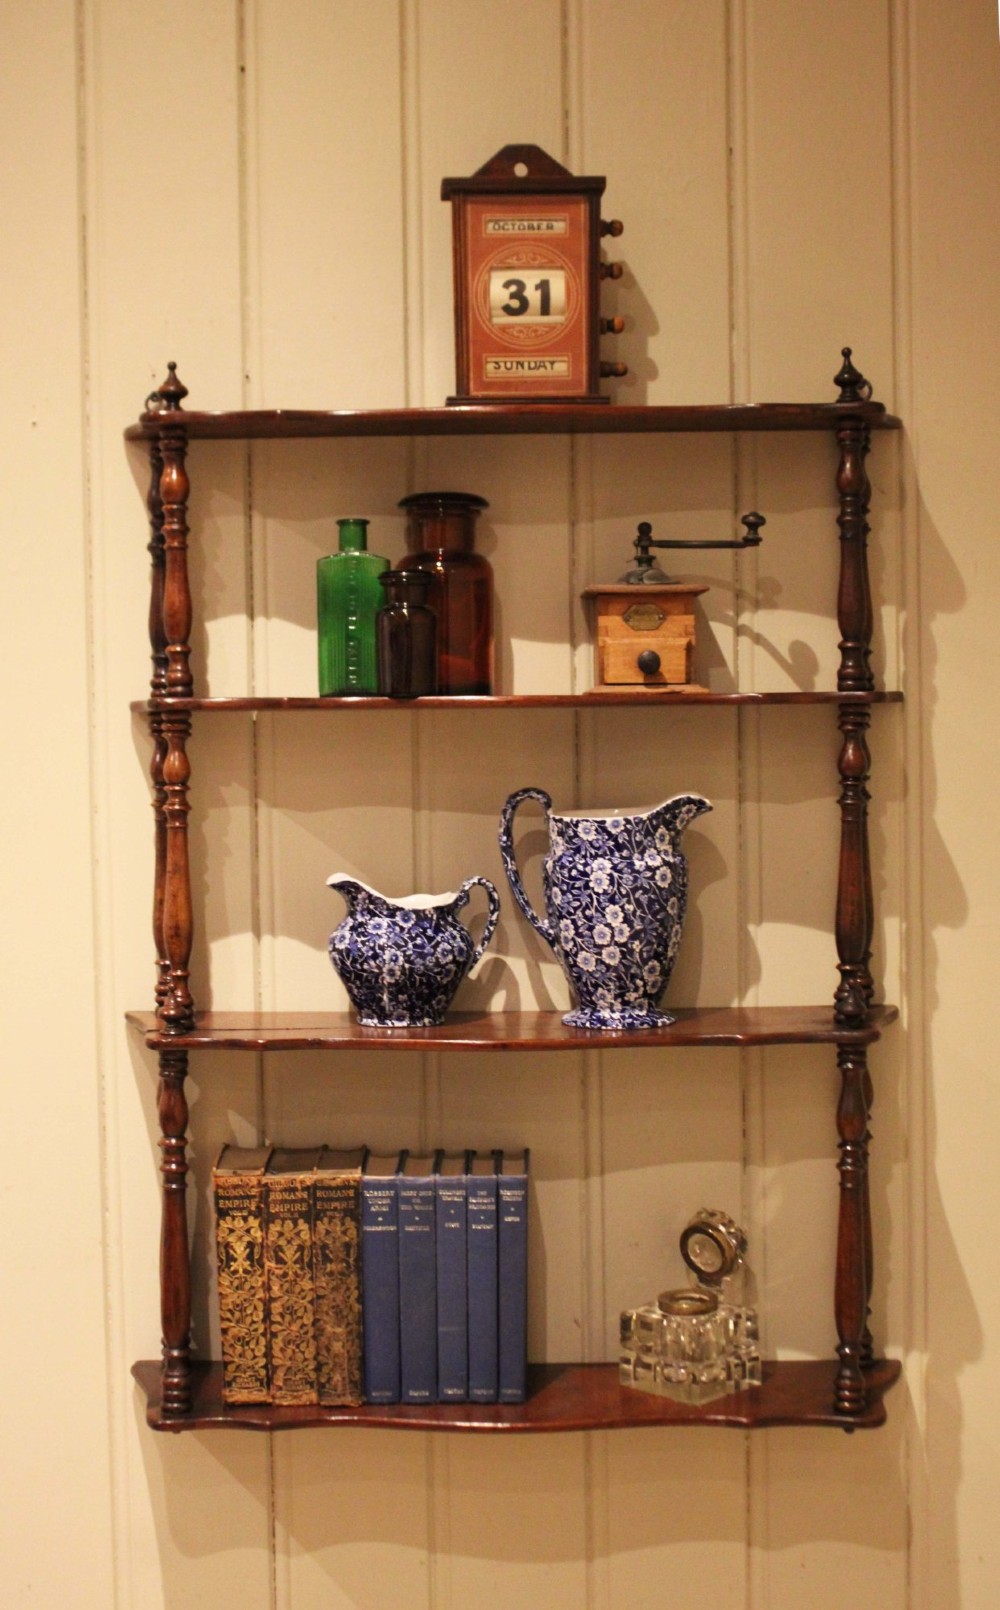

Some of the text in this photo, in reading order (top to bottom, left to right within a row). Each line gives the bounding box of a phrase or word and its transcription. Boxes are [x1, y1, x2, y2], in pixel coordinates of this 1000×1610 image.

[492, 221, 554, 231] OCTOBER
[502, 279, 551, 316] 31
[493, 360, 556, 371] SUNDAY
[269, 1203, 308, 1212] EMPIRE
